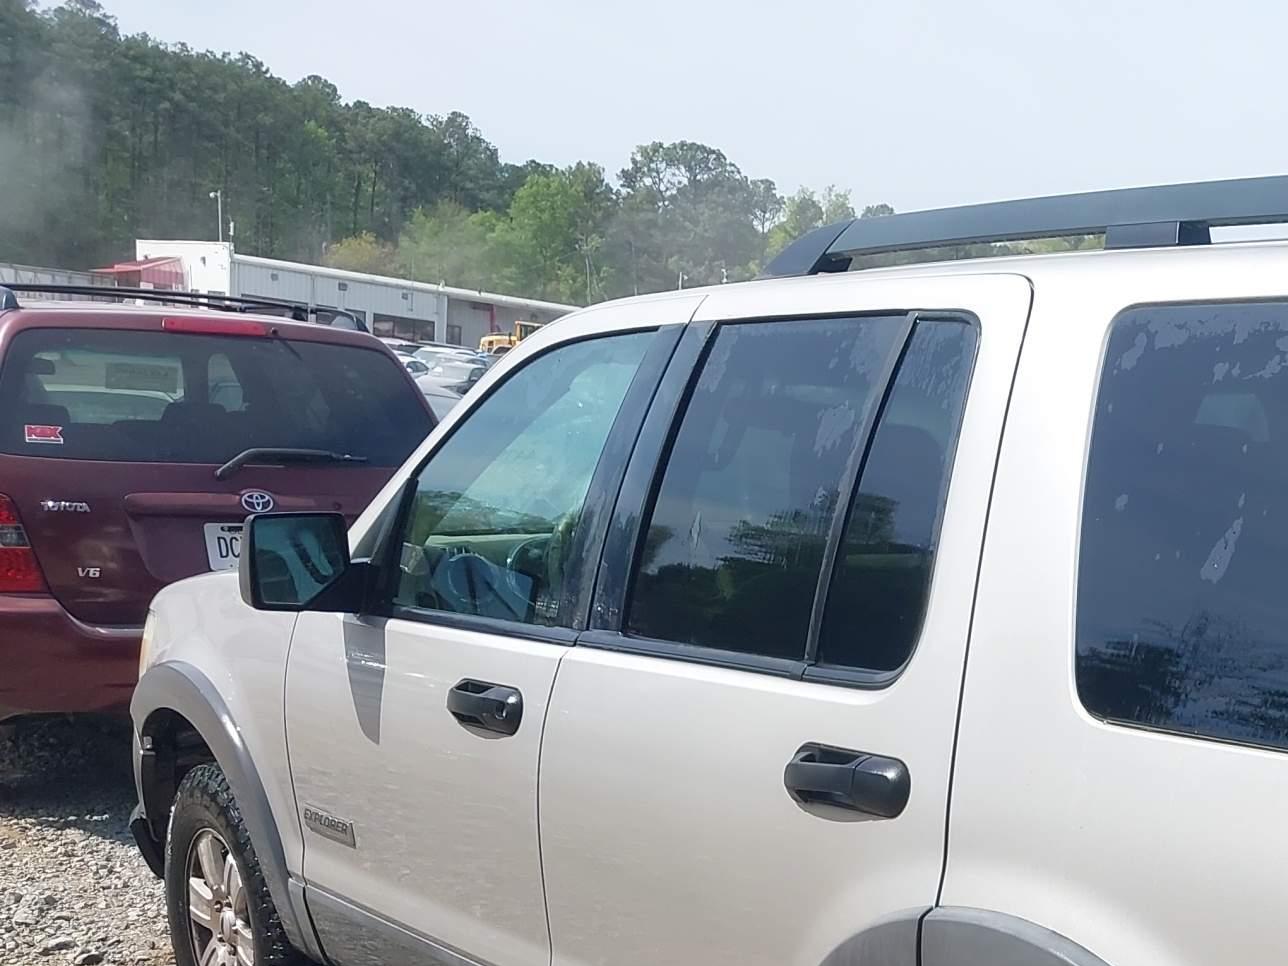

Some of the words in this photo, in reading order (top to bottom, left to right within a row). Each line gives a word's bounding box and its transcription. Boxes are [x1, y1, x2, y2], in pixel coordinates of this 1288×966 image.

[40, 500, 91, 512] TOYOTA
[217, 536, 243, 559] DC
[77, 567, 101, 578] V6
